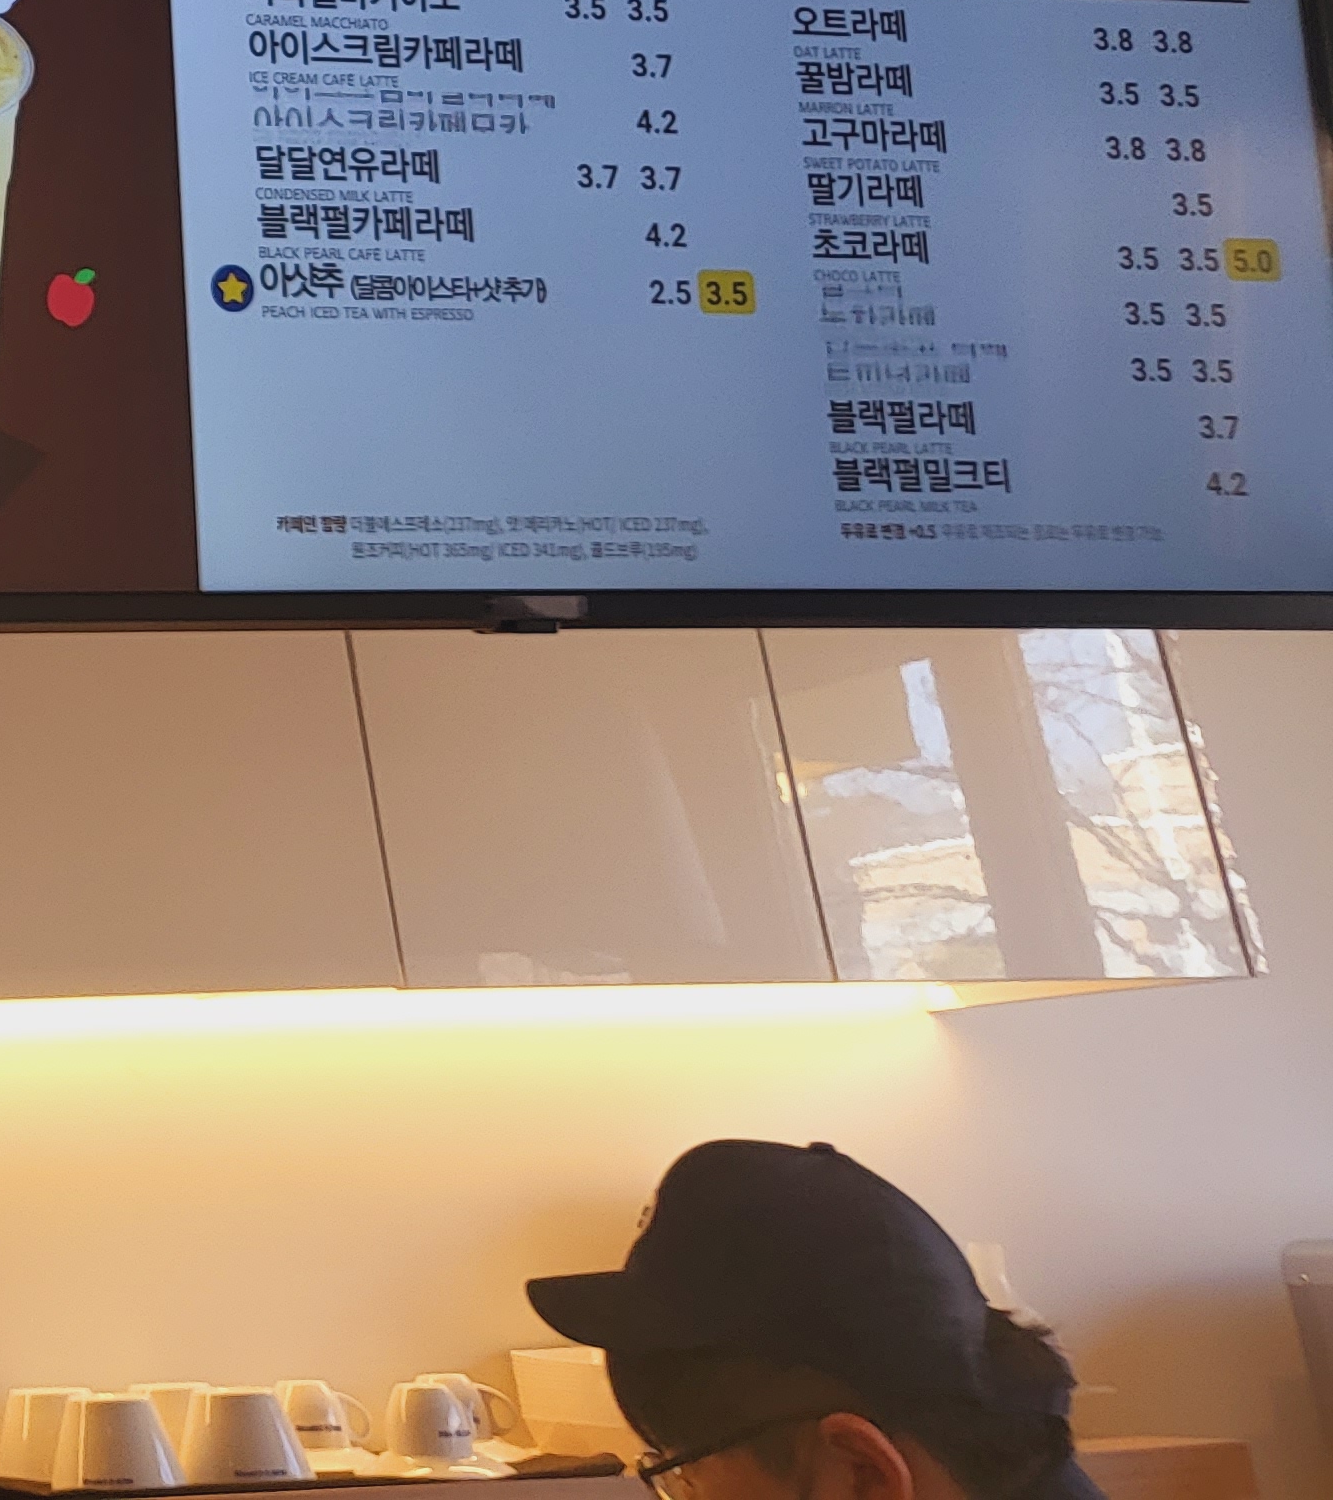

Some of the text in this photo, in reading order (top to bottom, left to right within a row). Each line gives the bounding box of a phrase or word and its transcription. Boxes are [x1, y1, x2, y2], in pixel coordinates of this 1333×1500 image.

[245, 14, 388, 31] CARAMEL MACCHIATO
[792, 7, 907, 42] 오트라떼
[248, 29, 523, 72] 아이스크림카페라떼
[1093, 28, 1193, 54] 3.8 3.8
[631, 54, 672, 79] 3.7
[795, 62, 913, 97] 꿀밤라떼
[636, 110, 678, 134] 4.2
[802, 119, 947, 153] 고구마라떼
[256, 146, 440, 184] 달달연유라떼
[807, 173, 924, 209] 딸기라떼
[1172, 192, 1213, 216] 3.5
[257, 204, 475, 242] 블랙펄카페라떼
[645, 223, 688, 247] 4.2
[812, 229, 929, 265] 초코라떼
[1118, 246, 1273, 273] 3.5 3.5 5.0
[260, 262, 344, 299] 아샷추
[650, 280, 748, 305] 2.5 3.5
[827, 400, 976, 435] 블랙펄라떼
[1199, 415, 1238, 440] 3.7
[834, 458, 1011, 493] 블랙펄밀크티
[1206, 472, 1247, 497] 4.2
